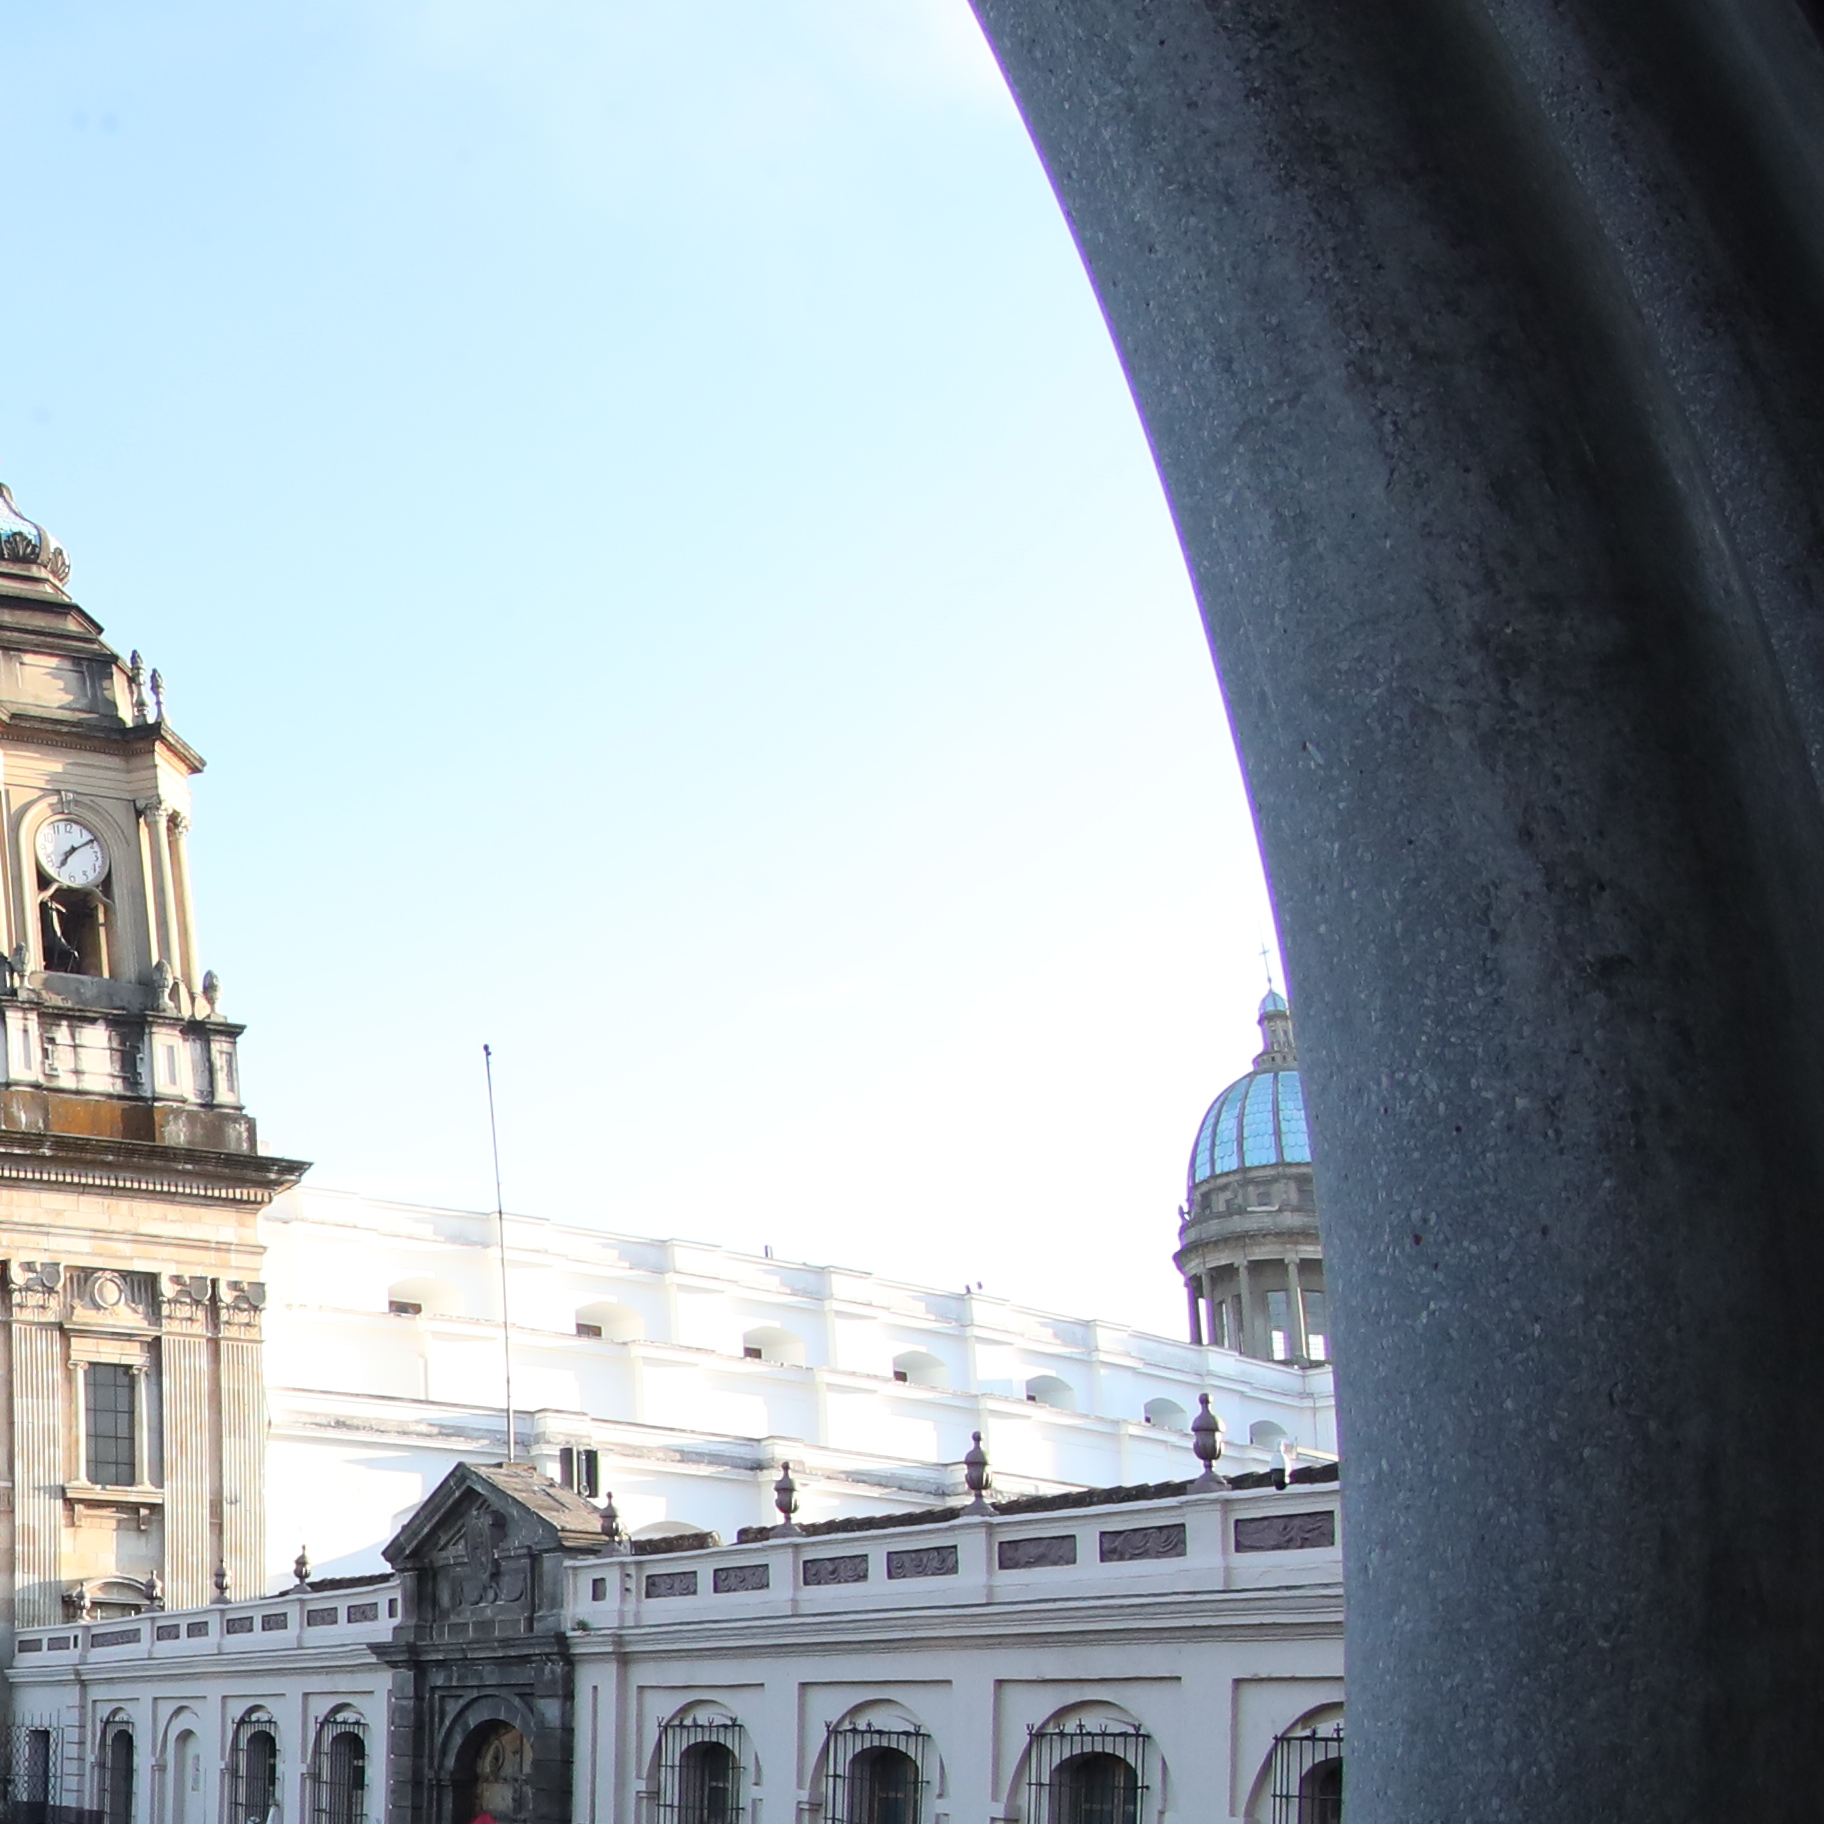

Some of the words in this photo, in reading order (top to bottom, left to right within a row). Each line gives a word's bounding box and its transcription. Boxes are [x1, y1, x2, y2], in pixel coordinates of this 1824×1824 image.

[52, 822, 60, 835] 11
[64, 822, 73, 834] 12
[43, 832, 53, 843] 10
[46, 855, 55, 867] 8
[92, 850, 99, 862] 3
[68, 872, 76, 883] 6
[81, 870, 89, 882] 5
